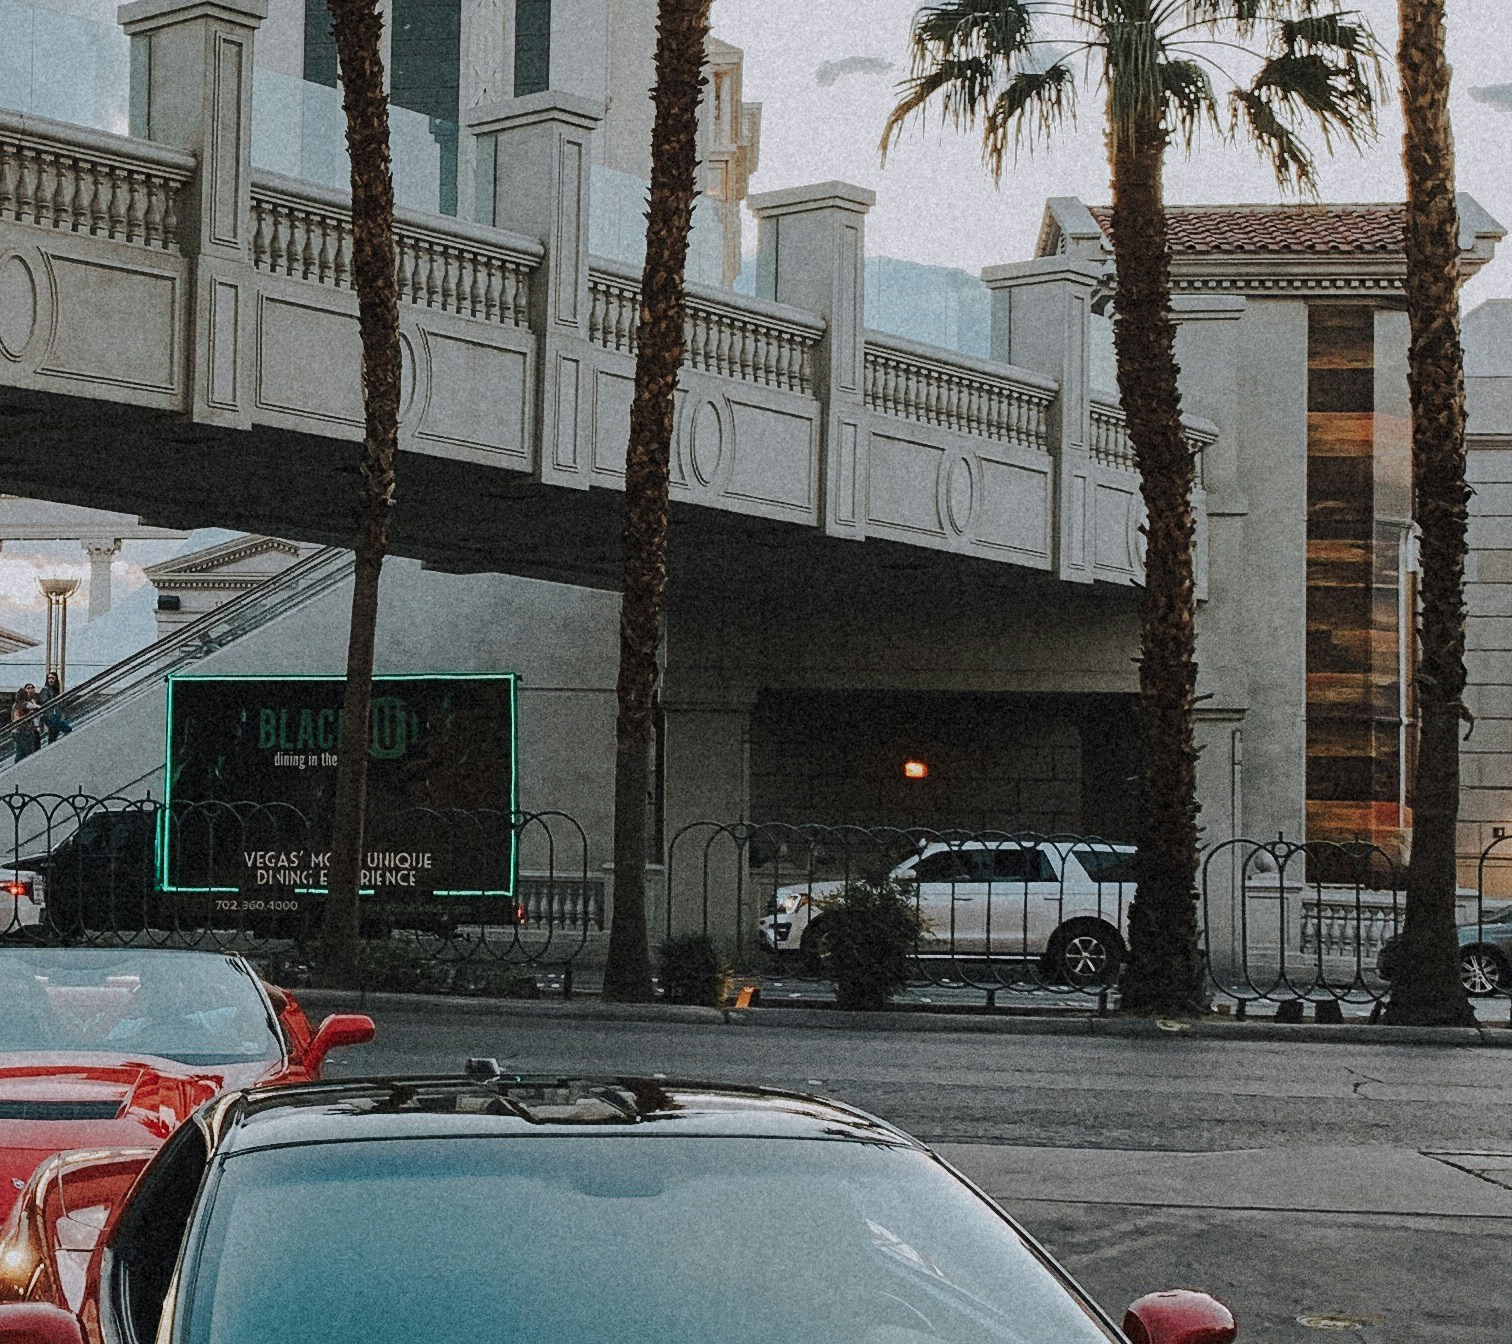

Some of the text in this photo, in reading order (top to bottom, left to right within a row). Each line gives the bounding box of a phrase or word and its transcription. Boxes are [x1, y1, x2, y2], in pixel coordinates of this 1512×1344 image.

[274, 752, 338, 769] dining in the
[367, 852, 432, 869] UNIQUE
[257, 869, 313, 886] DINING
